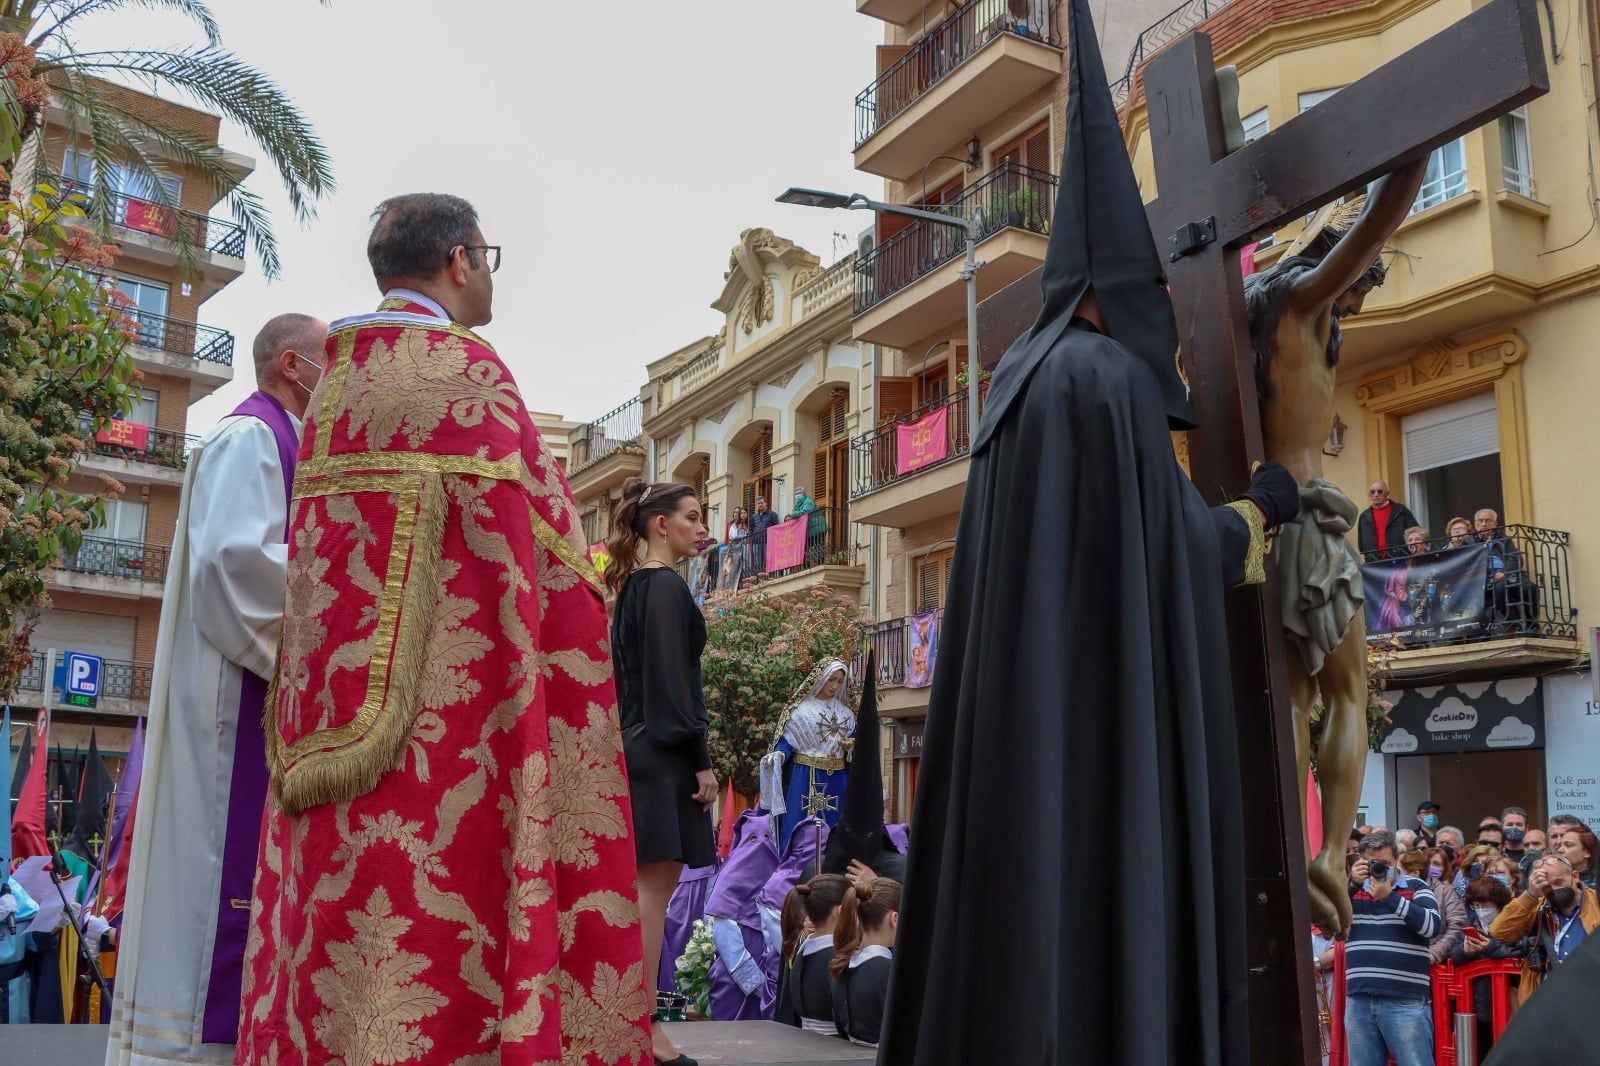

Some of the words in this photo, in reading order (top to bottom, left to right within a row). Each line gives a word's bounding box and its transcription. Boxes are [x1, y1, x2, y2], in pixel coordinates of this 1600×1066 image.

[72, 659, 90, 689] P
[1432, 712, 1476, 723] CookieDay
[1432, 731, 1449, 741] bake
[1451, 731, 1471, 741] shop
[1554, 775, 1574, 785] Café
[1577, 778, 1597, 788] para
[1555, 788, 1588, 798] Cookies
[1556, 801, 1595, 811] Brownies
